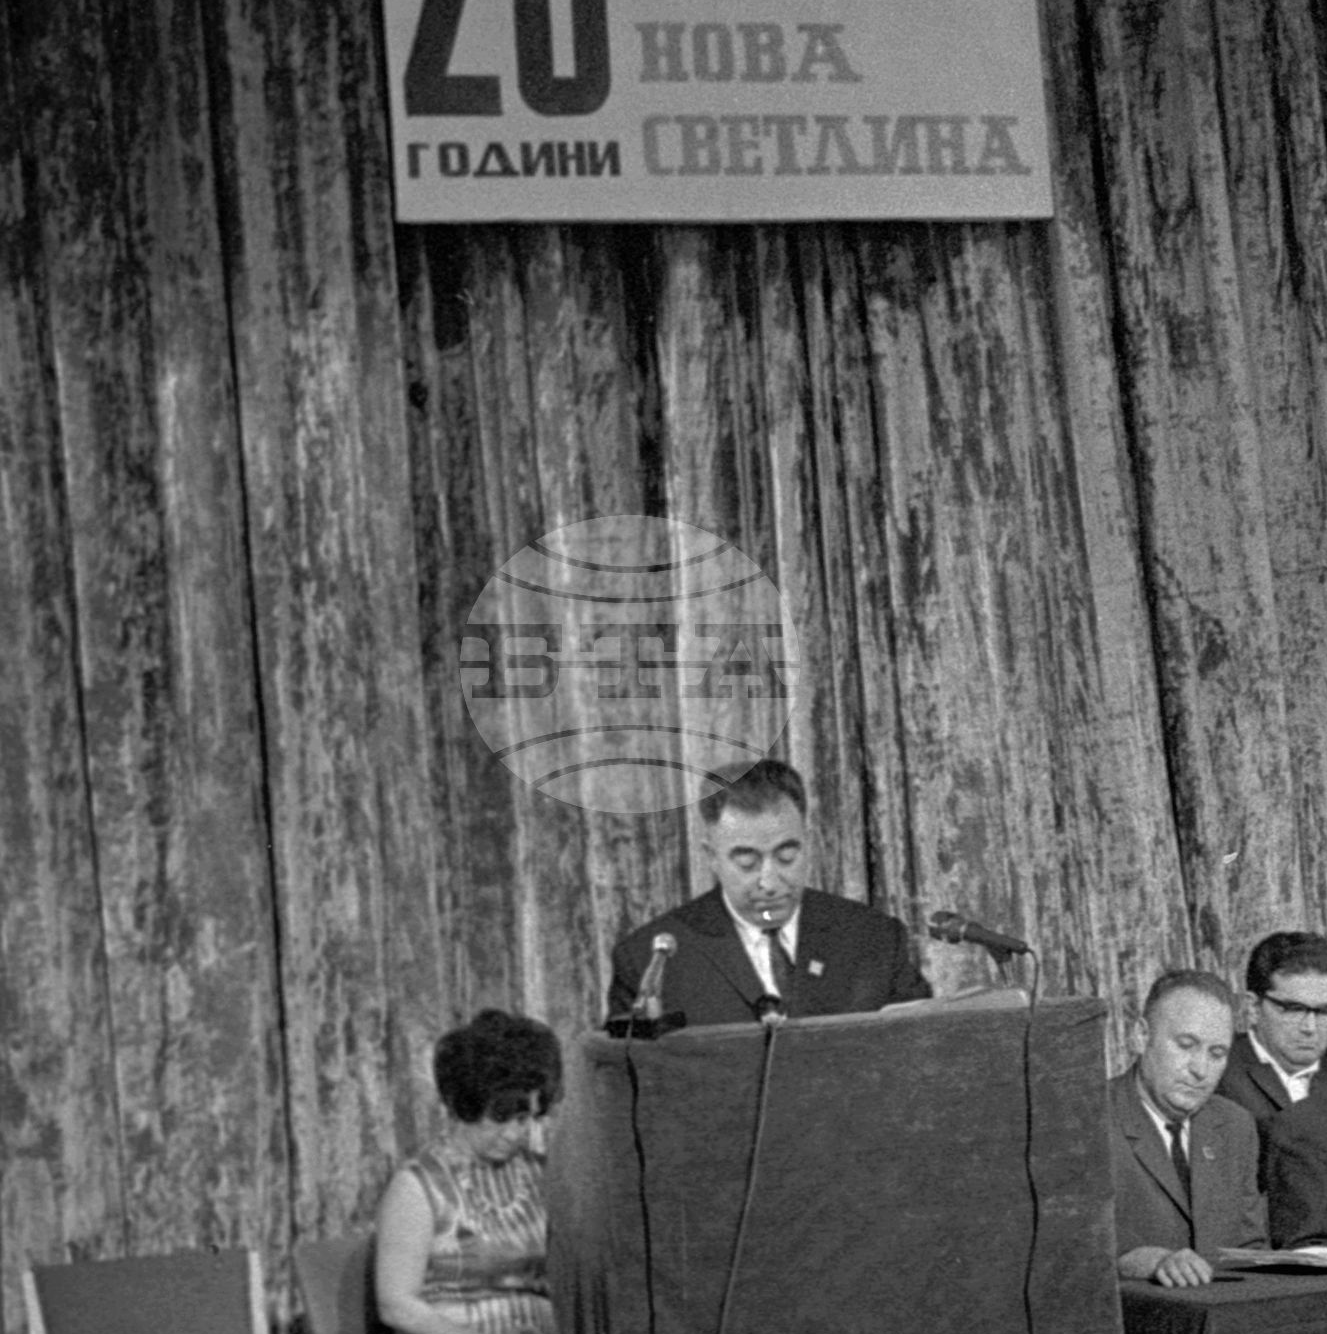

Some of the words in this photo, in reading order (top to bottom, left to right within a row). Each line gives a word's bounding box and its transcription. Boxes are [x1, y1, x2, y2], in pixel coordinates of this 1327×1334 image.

[634, 21, 864, 85] НОВА
[406, 140, 622, 180] ГОДИНИ
[641, 113, 1033, 178] СВЕТЛИНА
